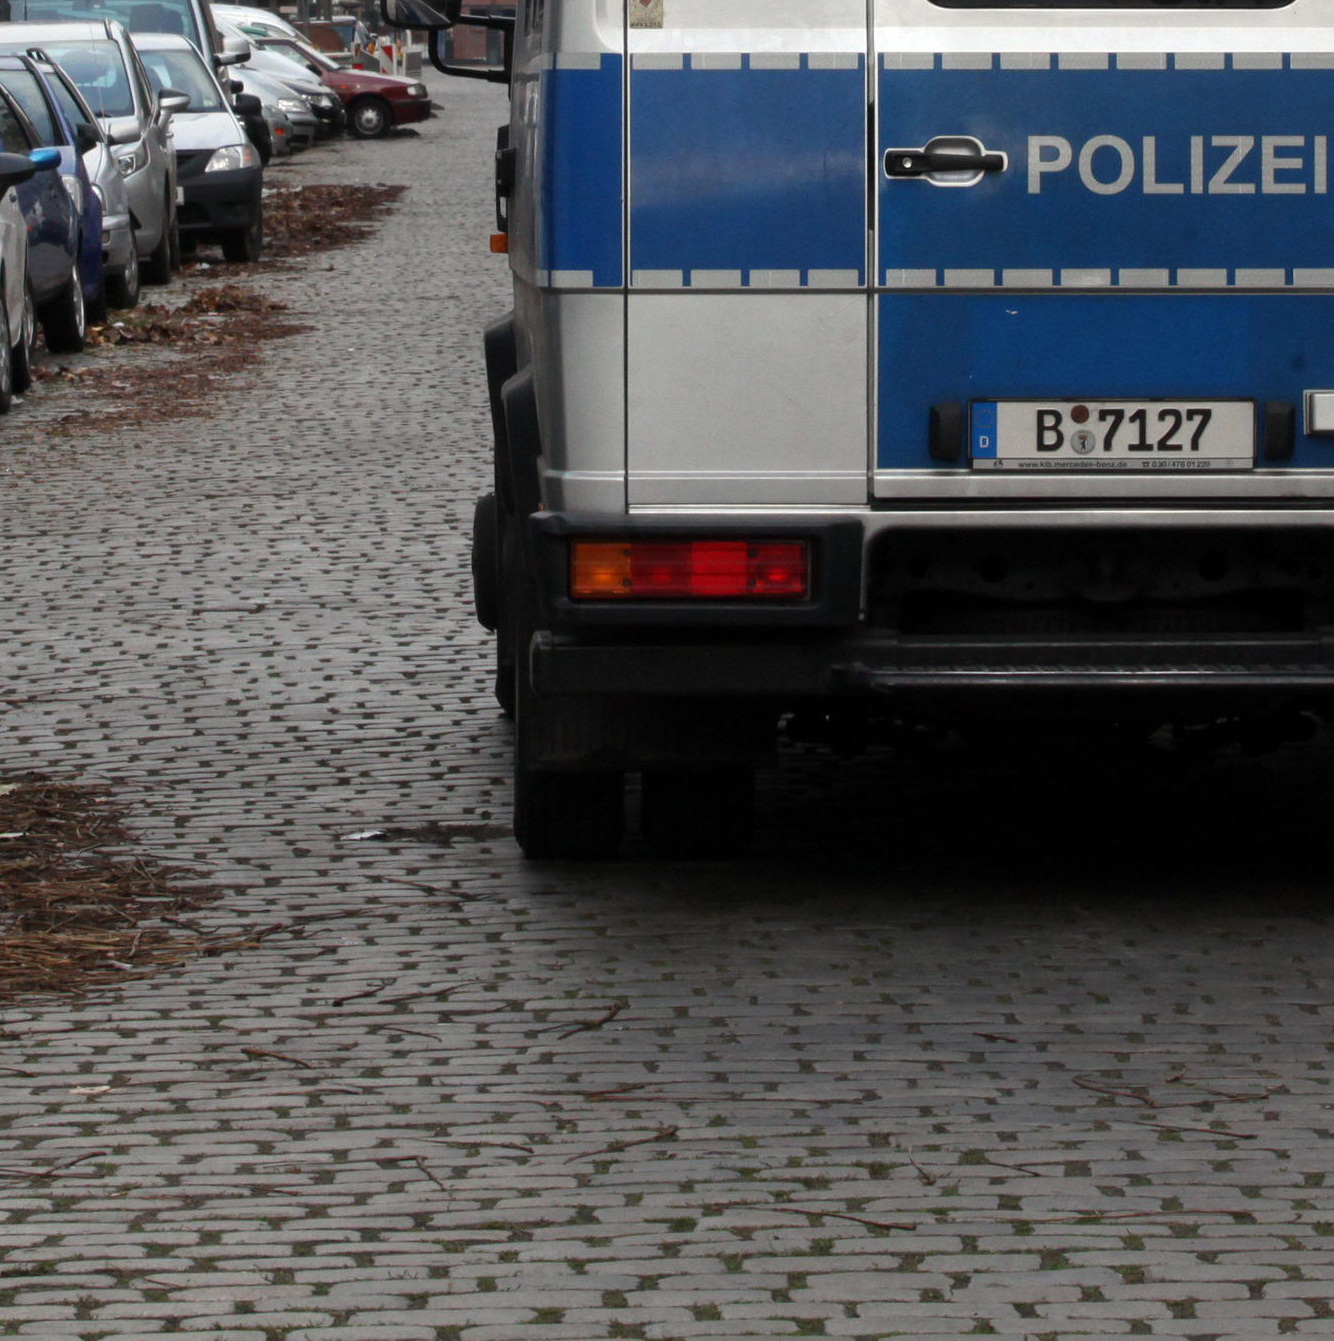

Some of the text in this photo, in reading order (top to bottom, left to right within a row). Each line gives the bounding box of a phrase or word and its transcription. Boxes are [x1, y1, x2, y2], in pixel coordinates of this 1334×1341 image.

[1027, 134, 1327, 195] POLIZEI
[979, 435, 989, 448] D
[1036, 409, 1212, 452] B 7127
